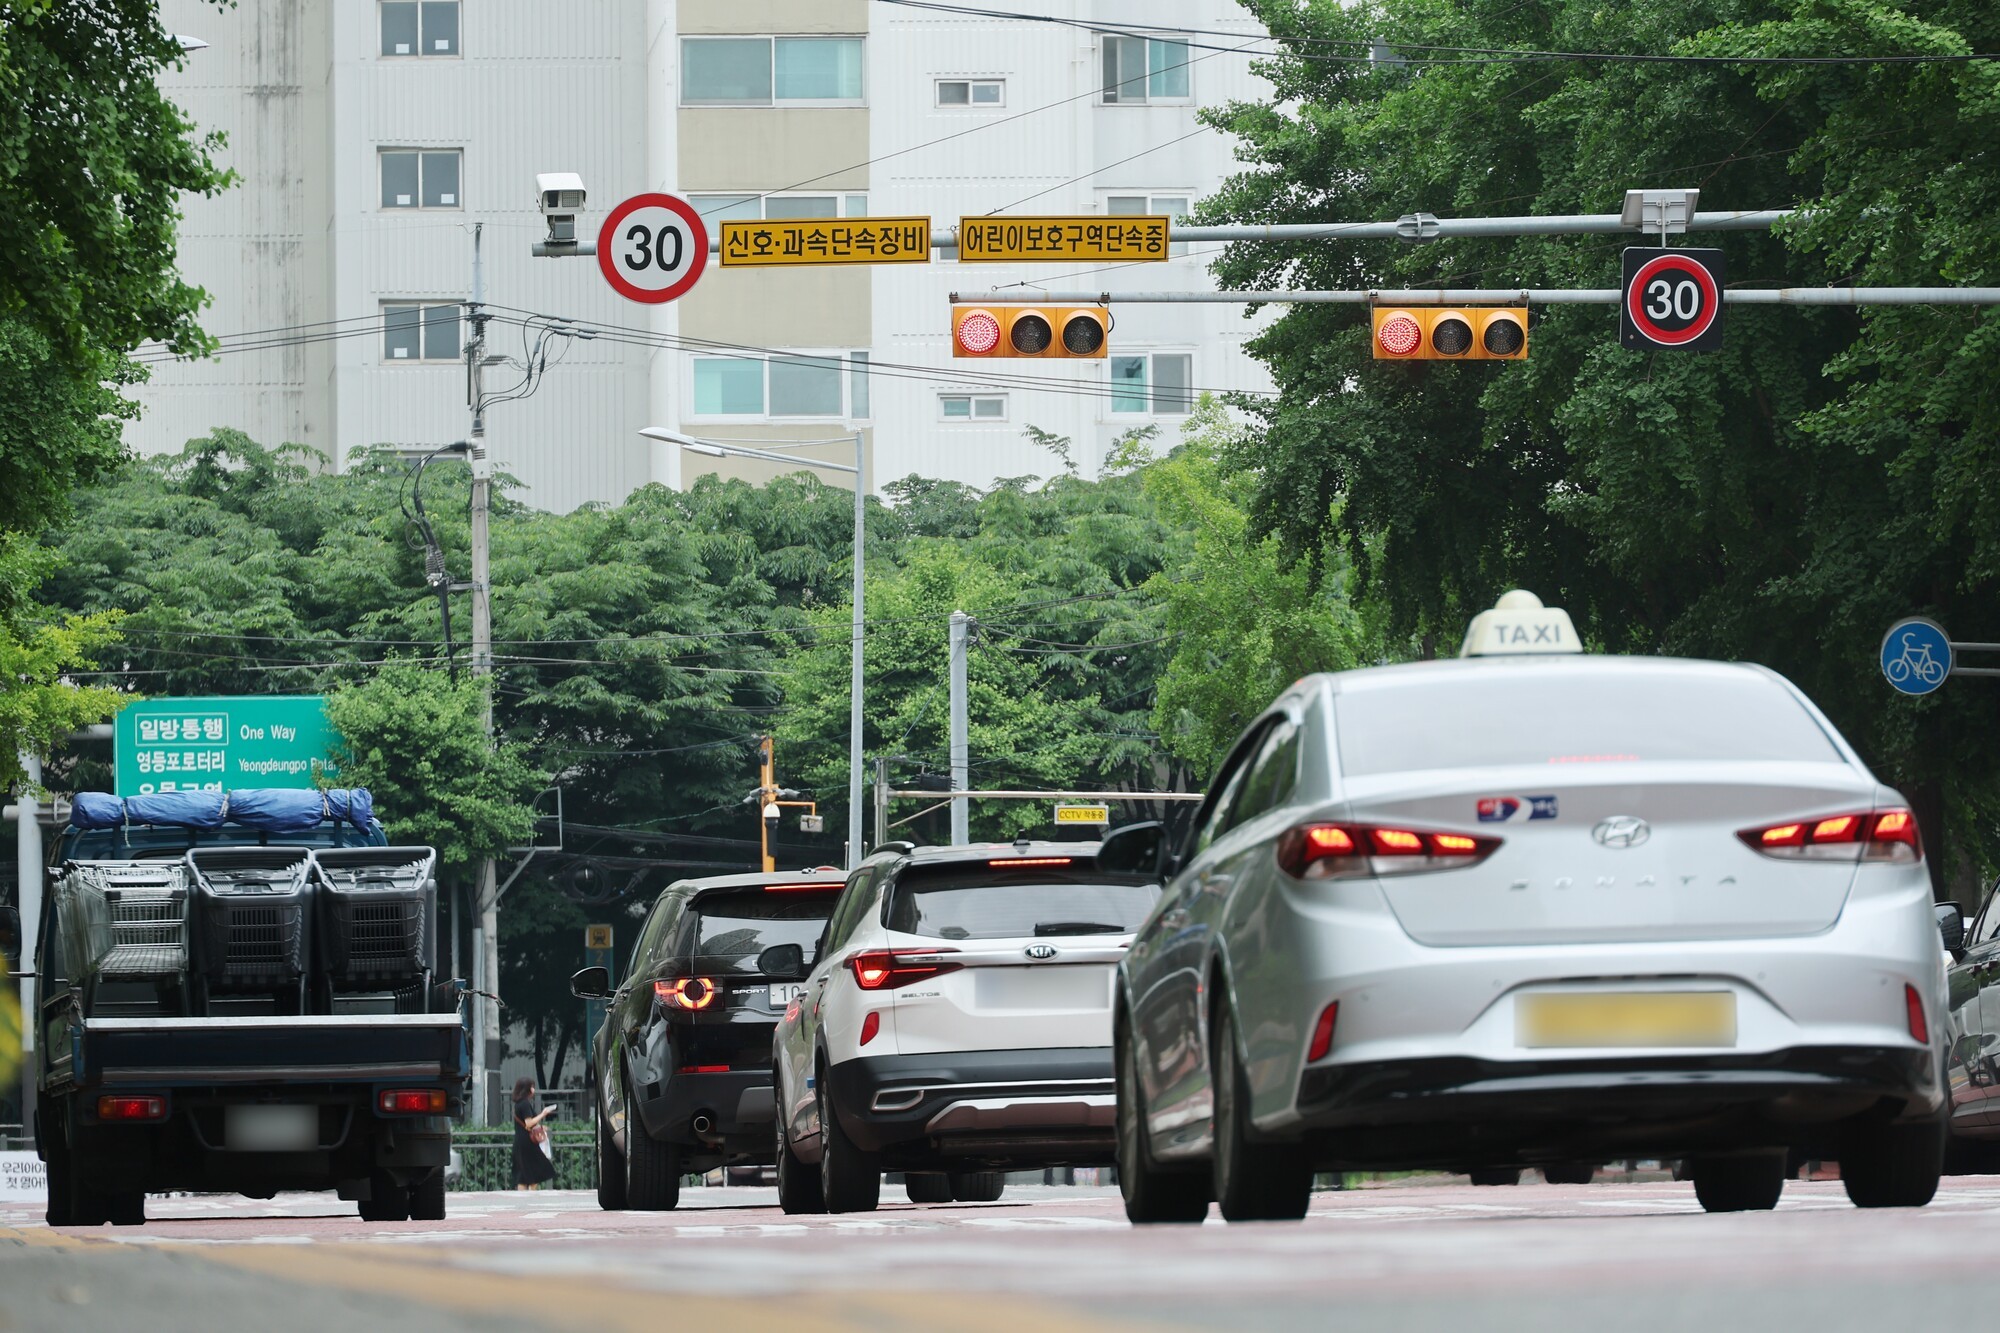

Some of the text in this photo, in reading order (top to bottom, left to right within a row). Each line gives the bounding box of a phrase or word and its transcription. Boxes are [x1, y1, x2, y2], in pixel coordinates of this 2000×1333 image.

[624, 224, 683, 272] 30
[727, 225, 924, 257] 신호·과속단속장비
[965, 225, 1163, 254] 어린이보호구역단속중
[1646, 279, 1699, 321] 30
[1495, 624, 1562, 645] TAXI
[139, 717, 224, 741] 일방통행
[240, 724, 296, 742] One Way
[136, 750, 225, 774] 영등포로터리
[238, 757, 307, 775] Yeongdeungpo
[1059, 810, 1082, 820] CCTV
[1509, 874, 1738, 891] SONATA
[1029, 946, 1054, 957] KIA
[732, 987, 767, 995] SPORT
